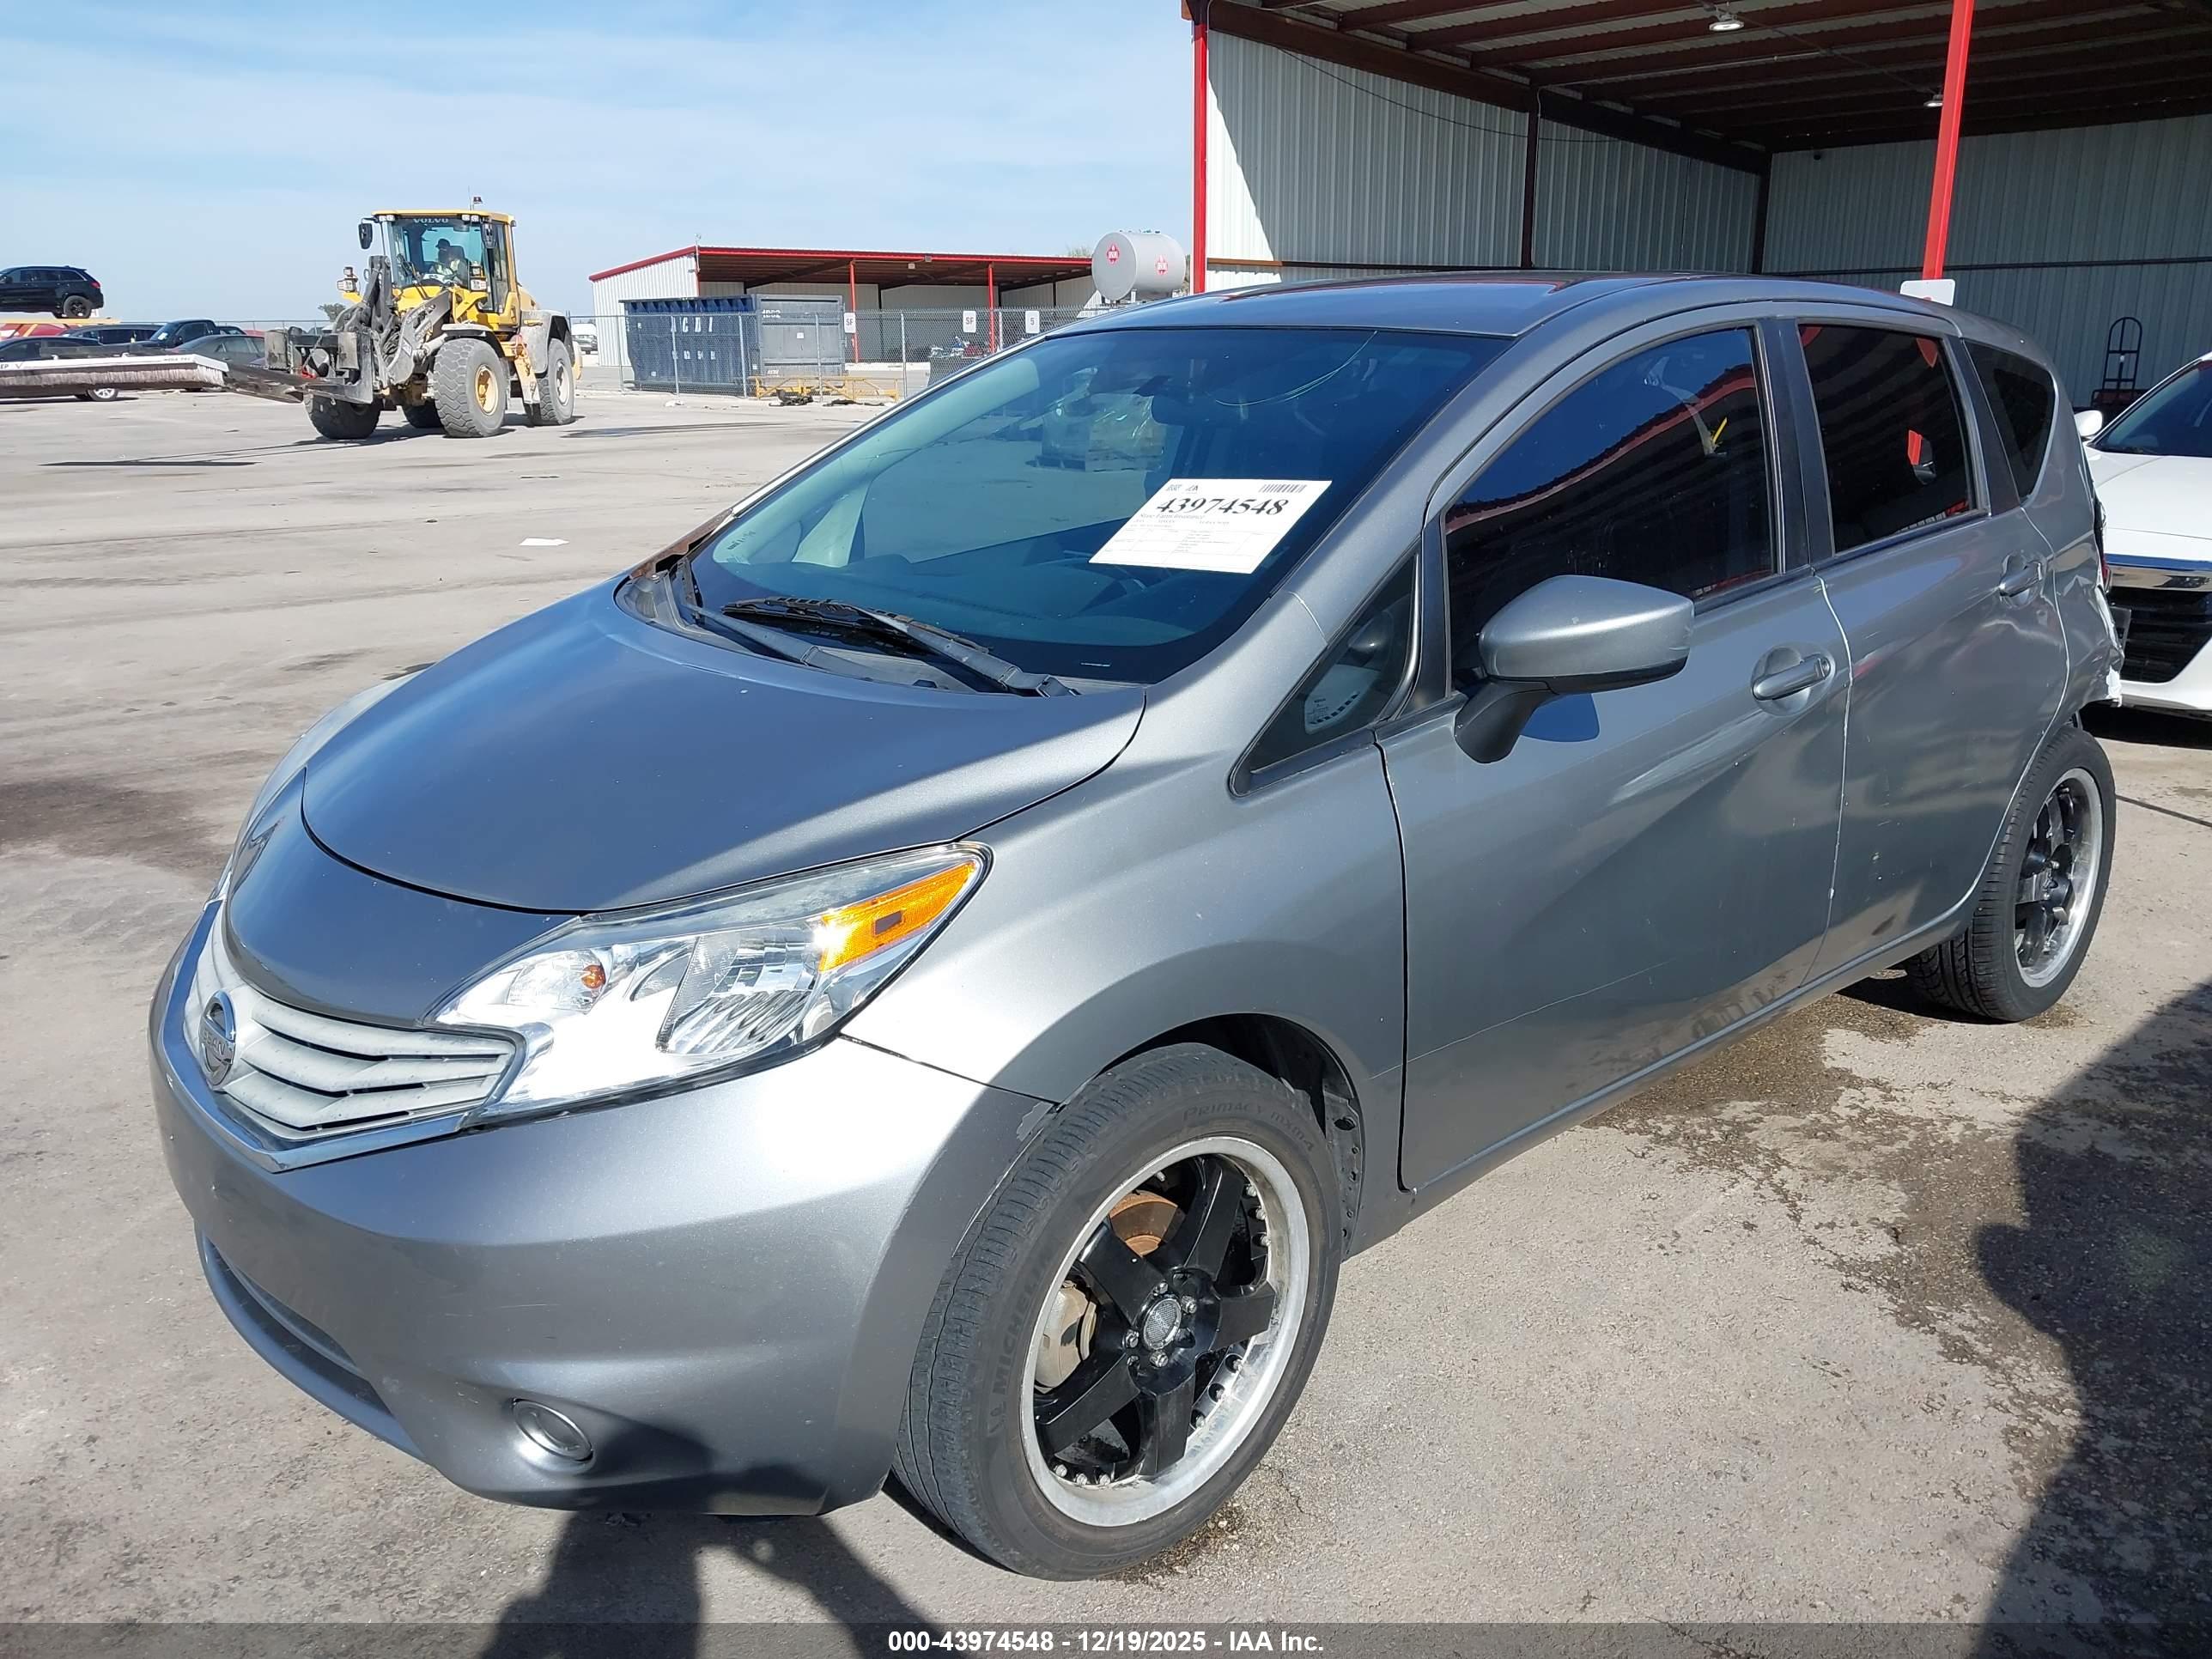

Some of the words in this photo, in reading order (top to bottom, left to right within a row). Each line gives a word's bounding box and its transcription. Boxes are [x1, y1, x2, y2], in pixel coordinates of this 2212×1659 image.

[846, 318, 853, 326] SF
[1156, 498, 1289, 515] 43974548
[1183, 1103, 1263, 1121] PRIMACY
[993, 1255, 1052, 1395] MICHELIN
